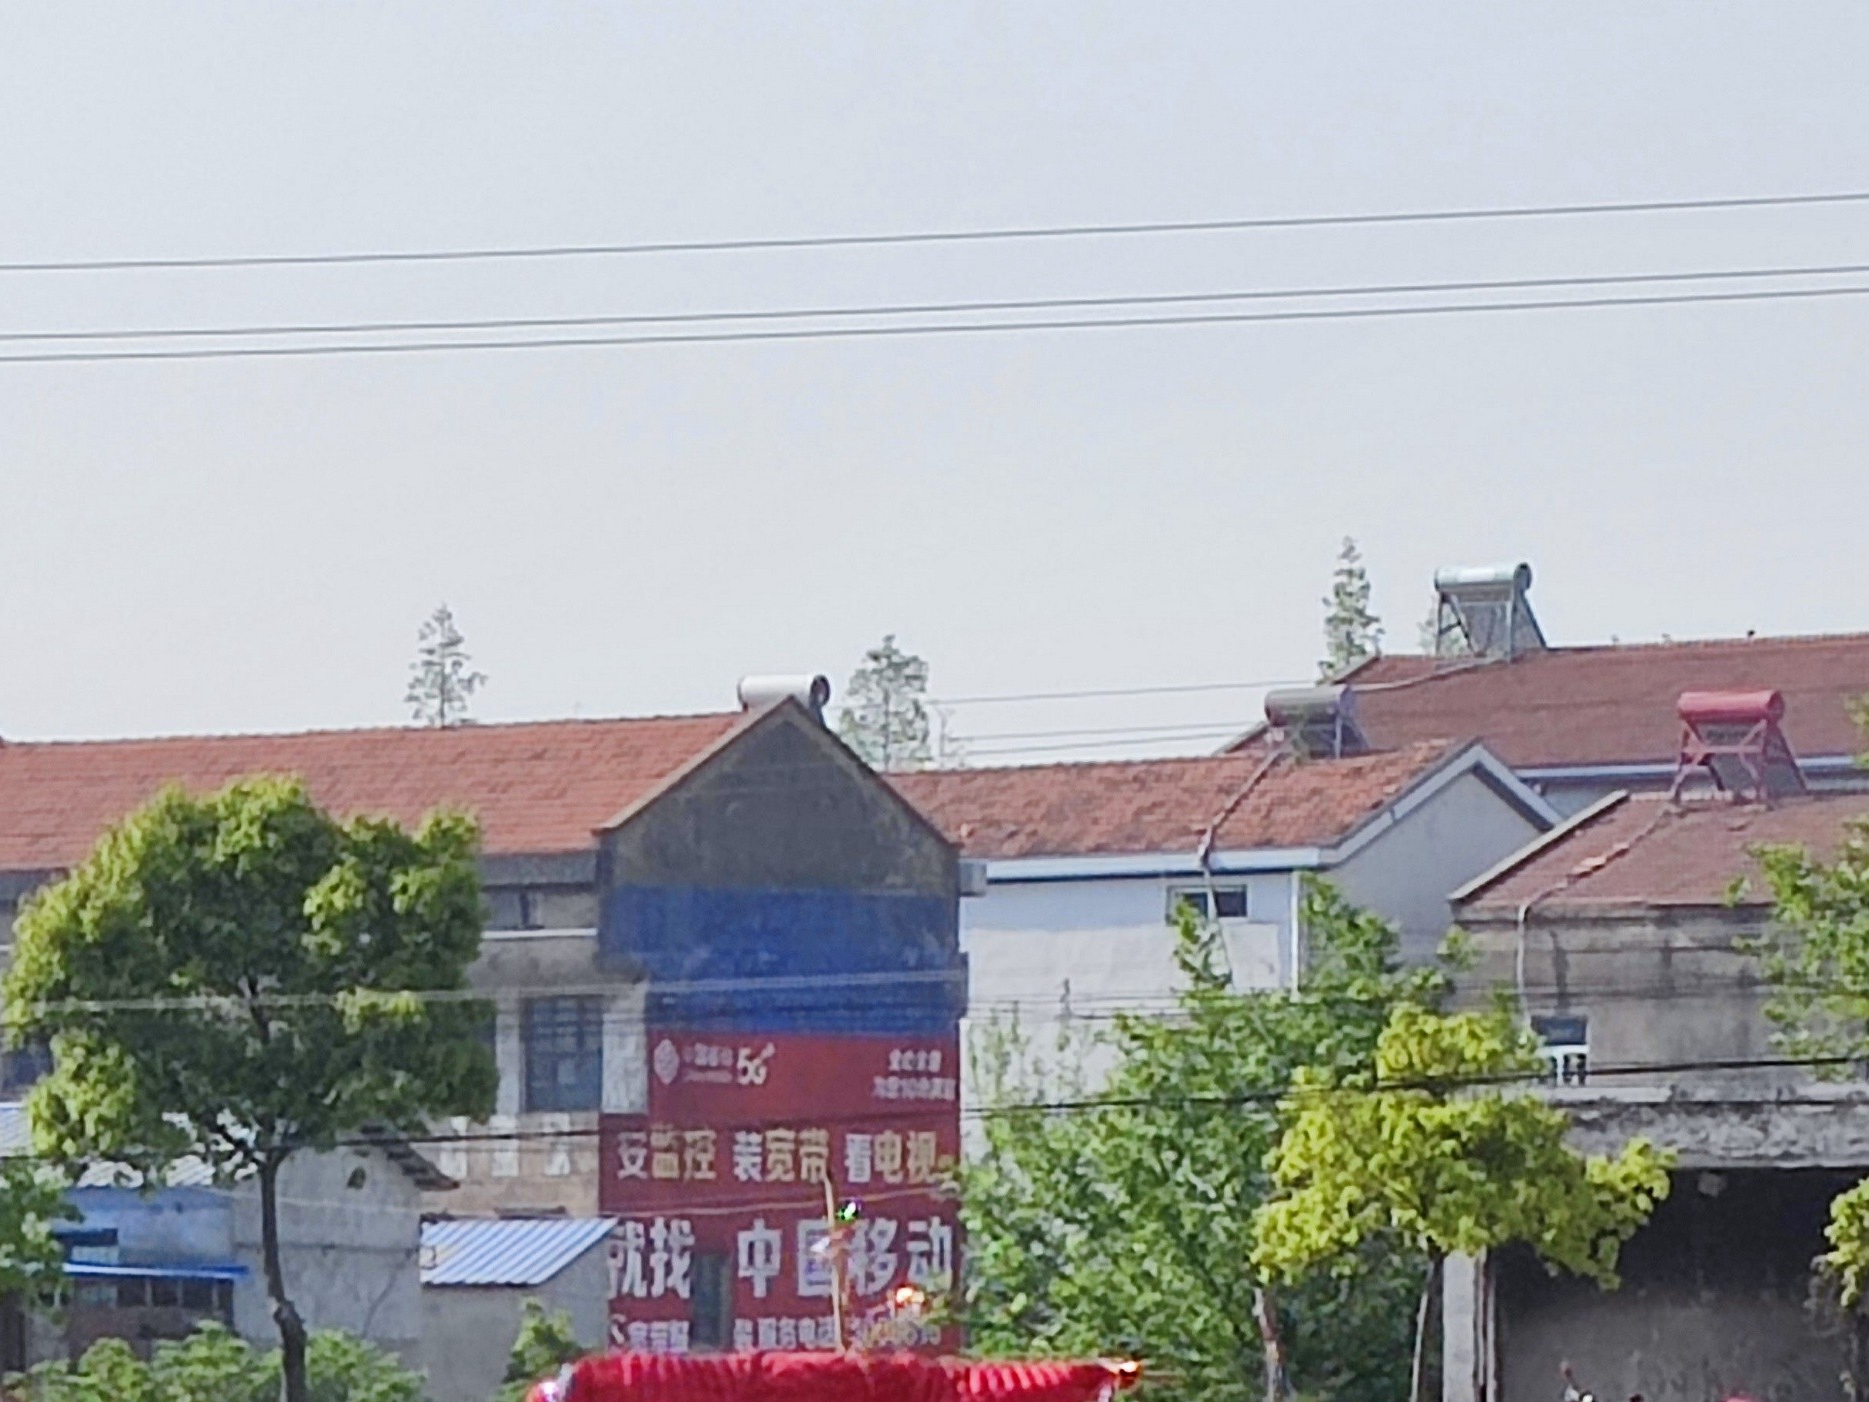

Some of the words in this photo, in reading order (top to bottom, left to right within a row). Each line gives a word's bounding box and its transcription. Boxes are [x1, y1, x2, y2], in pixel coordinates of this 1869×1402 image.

[732, 1127, 829, 1184] 装宽带
[844, 1129, 942, 1184] 看电视
[736, 1216, 953, 1300] 中国移动
